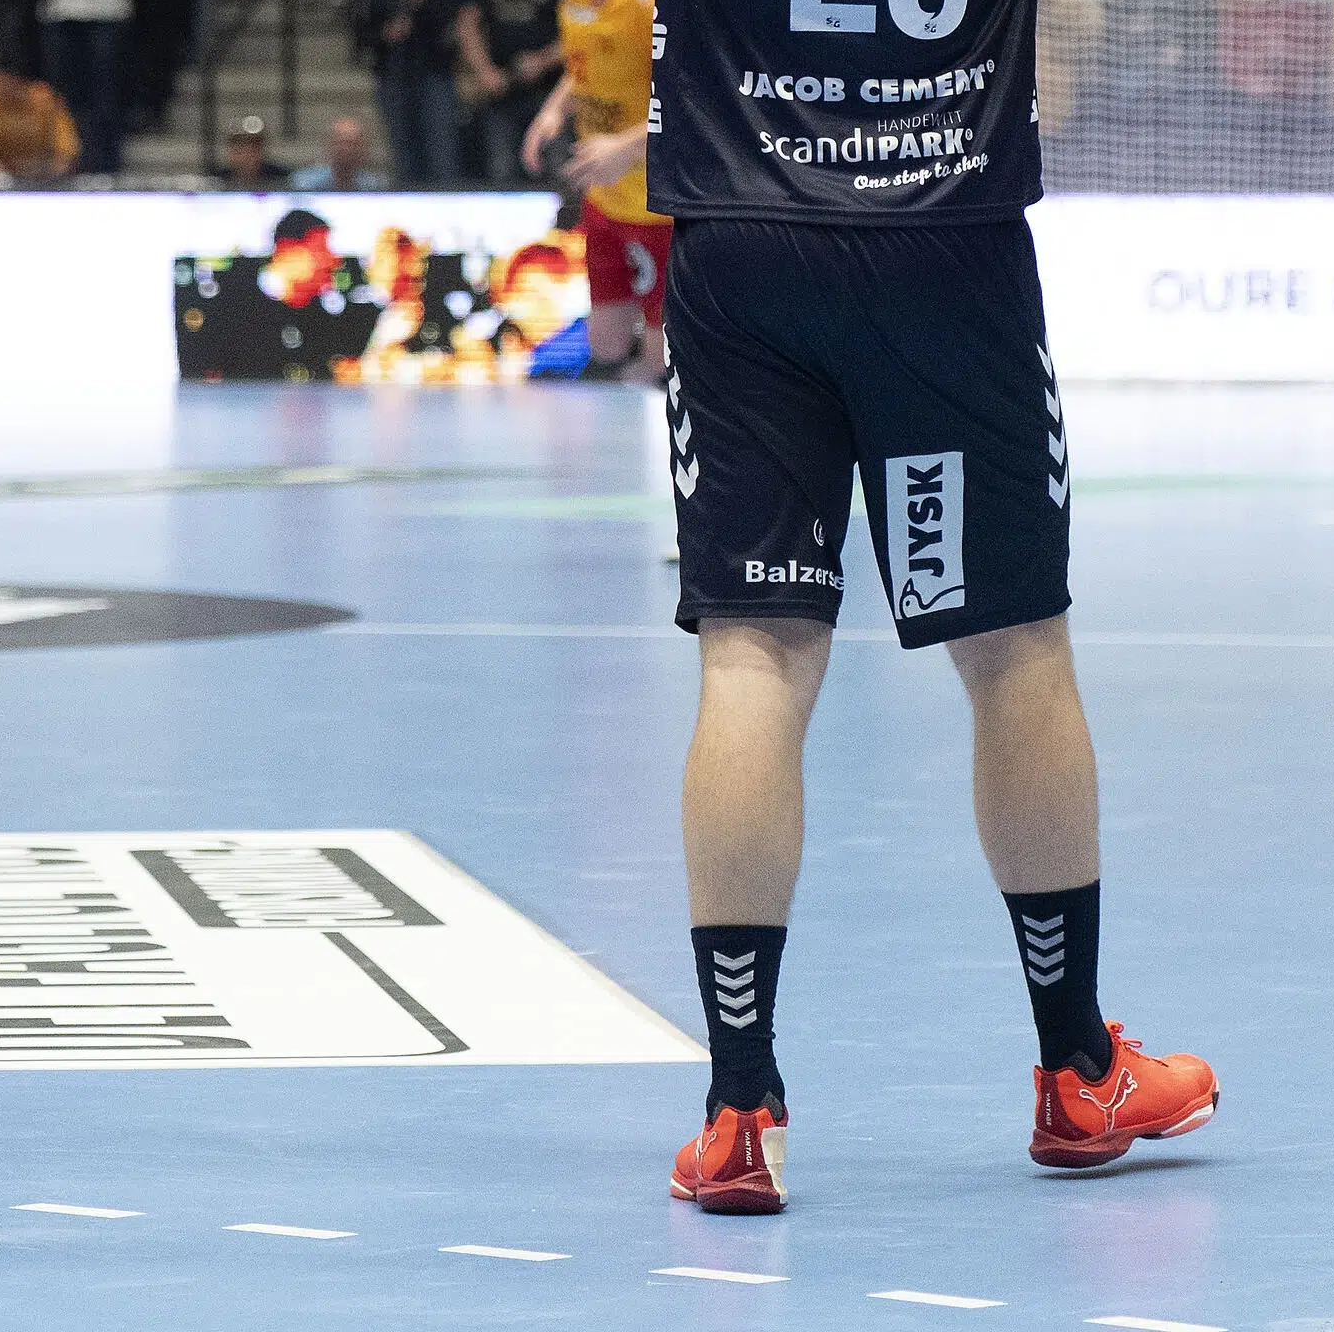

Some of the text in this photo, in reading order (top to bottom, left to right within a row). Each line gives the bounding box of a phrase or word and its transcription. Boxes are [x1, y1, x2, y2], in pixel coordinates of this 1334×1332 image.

[739, 71, 846, 102] JACOB
[854, 152, 990, 190] One stop to shop
[1147, 268, 1313, 315] OURE
[906, 461, 944, 578] JYSK
[745, 560, 844, 590] Balzerse
[745, 1131, 753, 1166] VANTAGE
